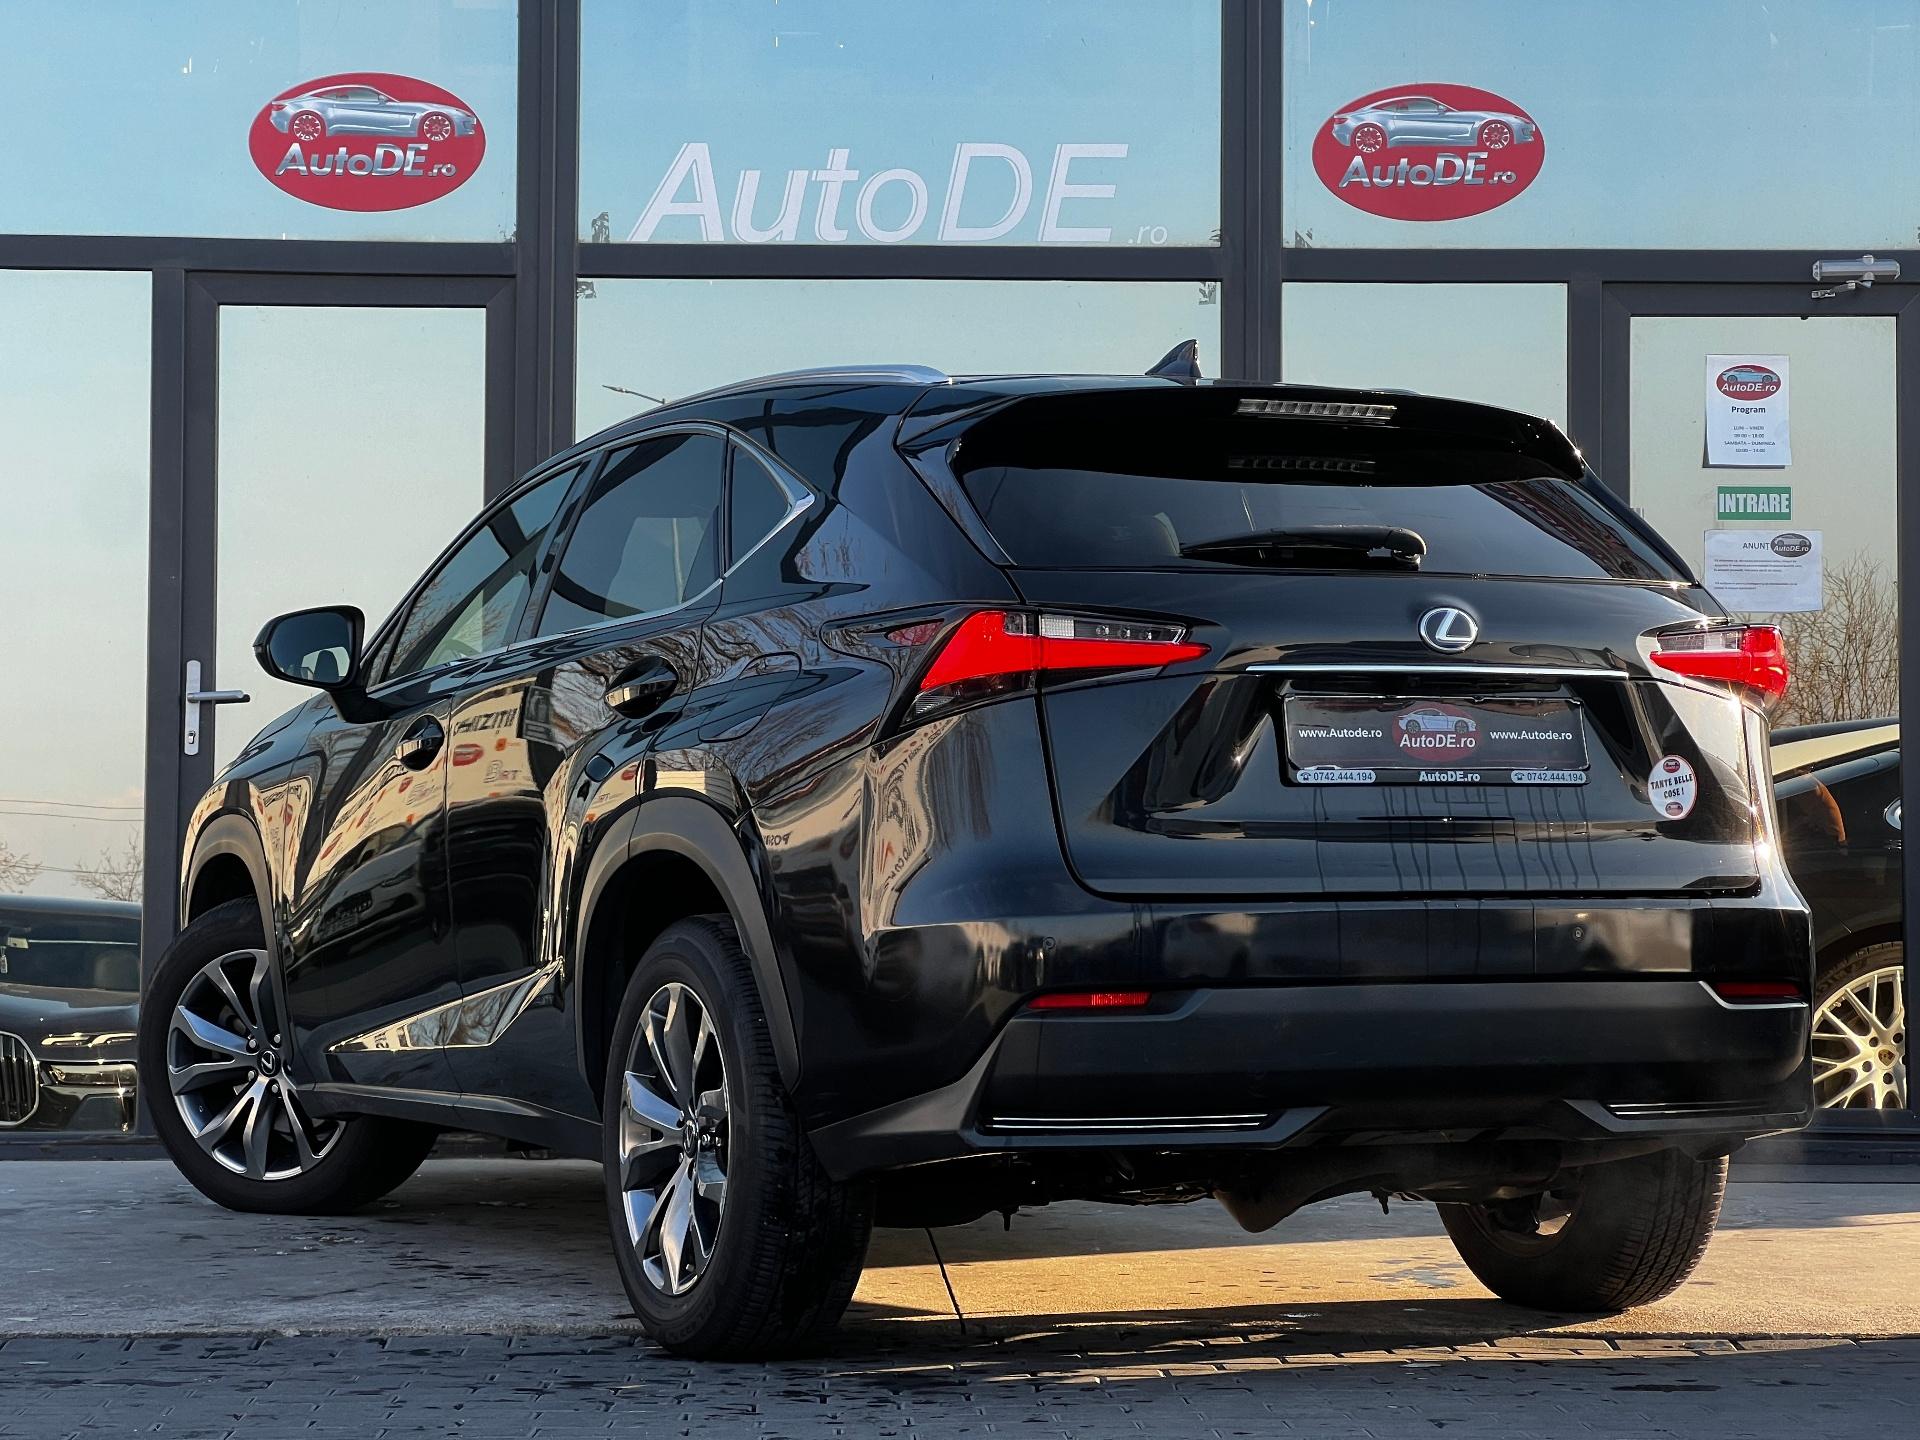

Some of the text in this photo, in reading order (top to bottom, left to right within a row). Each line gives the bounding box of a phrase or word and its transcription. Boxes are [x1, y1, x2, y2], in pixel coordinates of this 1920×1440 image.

[1721, 383, 1777, 392] AutoDE.ro
[1731, 406, 1766, 414] Program
[1719, 493, 1790, 513] INTRARE
[1298, 727, 1573, 749] www.Autode.ro AutoDE.ro www.Autode.ro
[1313, 771, 1584, 783] 0742.444.194 AutoDE.ro 0742.444.194
[1650, 773, 1693, 790] TANTE BELLE
[1663, 788, 1681, 799] COSE
